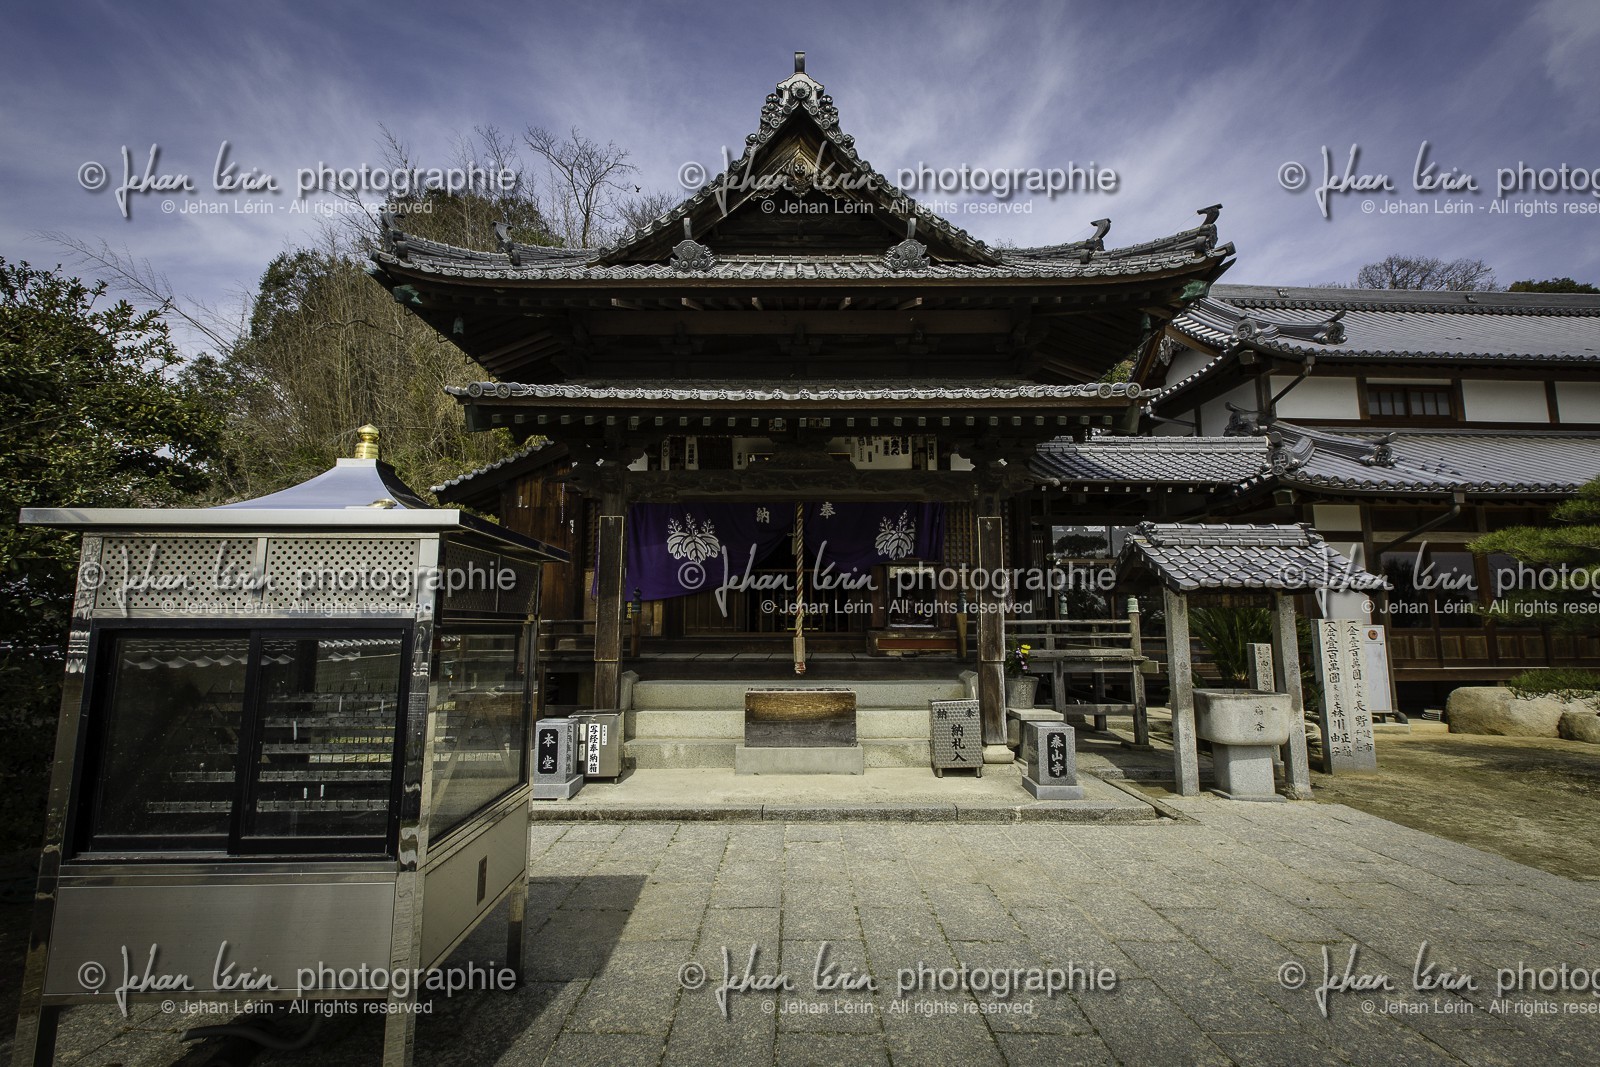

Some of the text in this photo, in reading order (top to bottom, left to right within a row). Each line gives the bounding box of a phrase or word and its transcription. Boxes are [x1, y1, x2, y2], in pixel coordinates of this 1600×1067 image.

[542, 733, 556, 770] 本堂
[589, 725, 598, 773] 写経奉納箱
[951, 723, 967, 762] 納札入
[1050, 734, 1064, 777] 泰山寺
